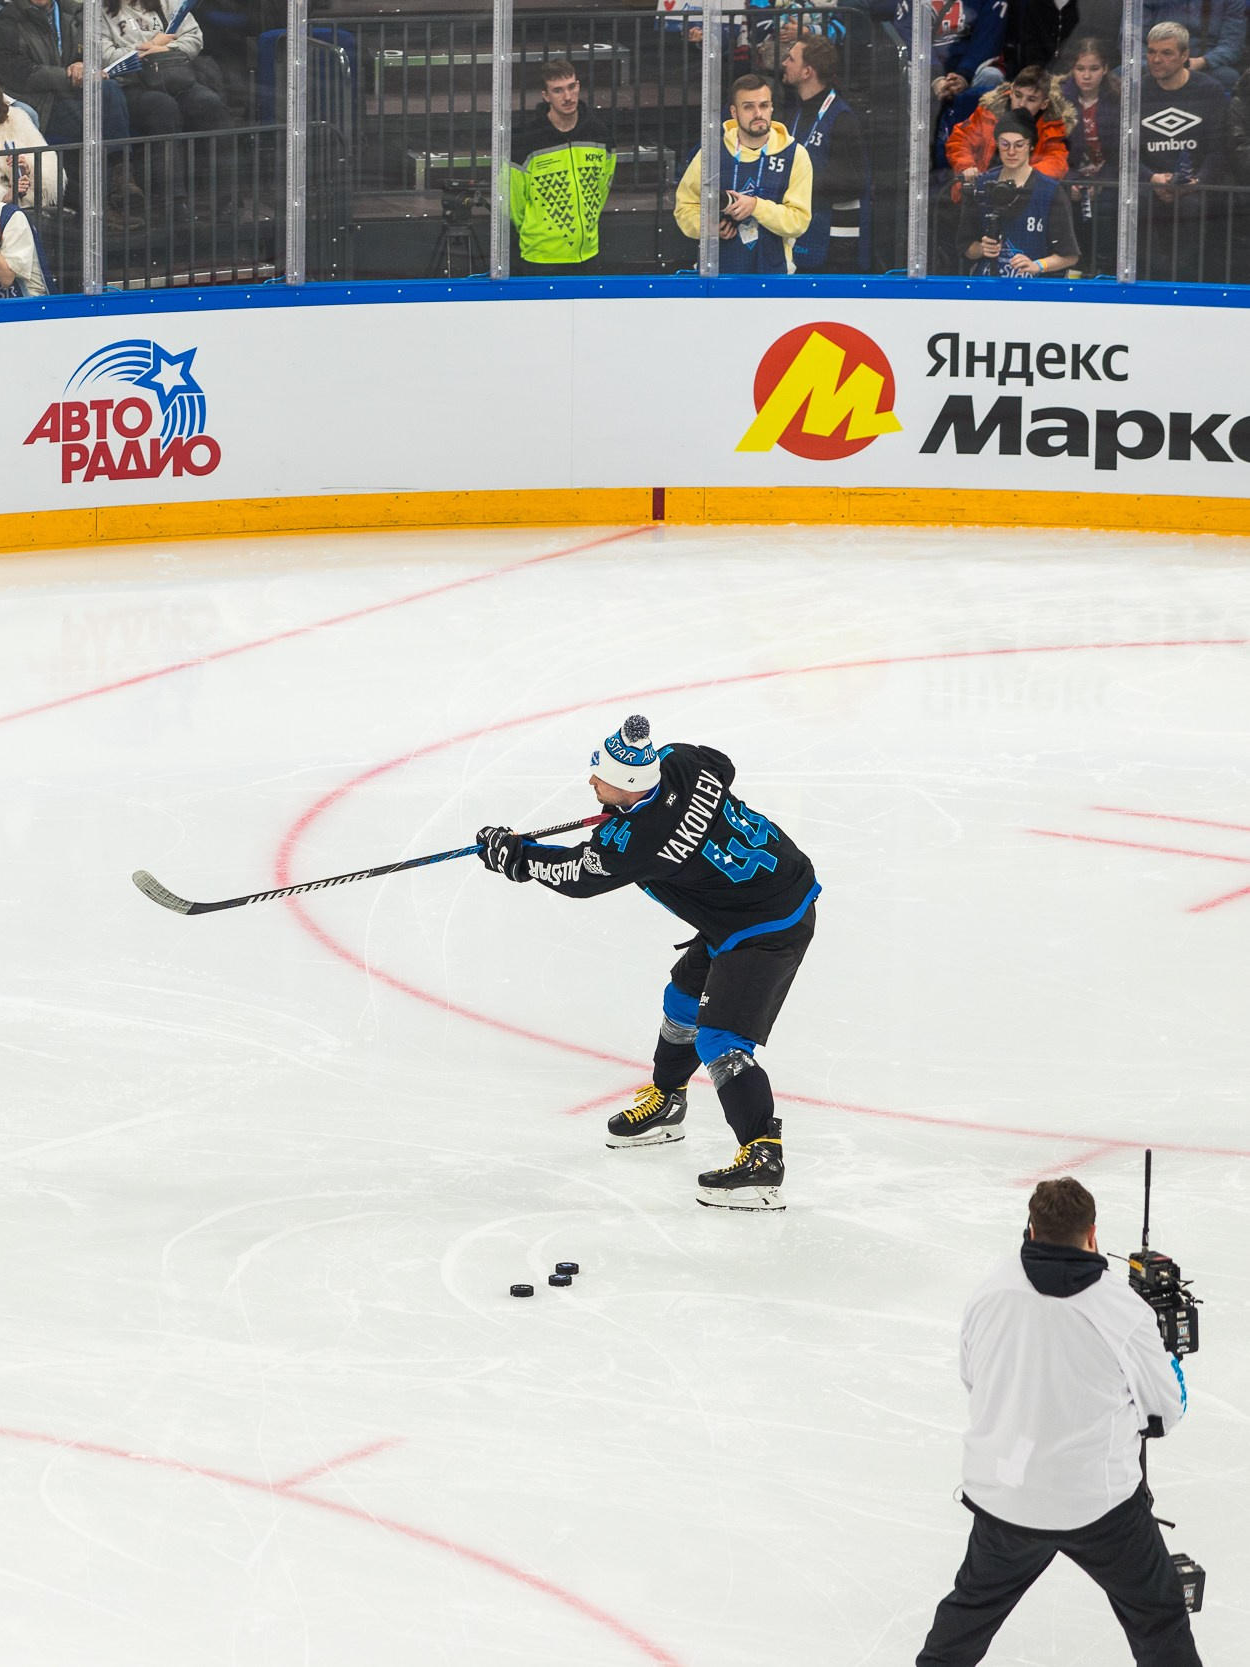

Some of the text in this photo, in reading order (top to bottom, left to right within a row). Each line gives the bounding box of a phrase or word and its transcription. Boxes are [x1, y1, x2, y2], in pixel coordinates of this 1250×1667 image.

[768, 156, 785, 173] 55
[1147, 138, 1197, 152] umbro
[1026, 216, 1044, 232] 86
[925, 332, 1129, 387] Яндекс
[22, 396, 153, 446] АВТО
[61, 434, 222, 484] РАДИО
[599, 817, 632, 853] 44
[656, 768, 723, 865] YAKOVLEV
[701, 798, 780, 884] 44
